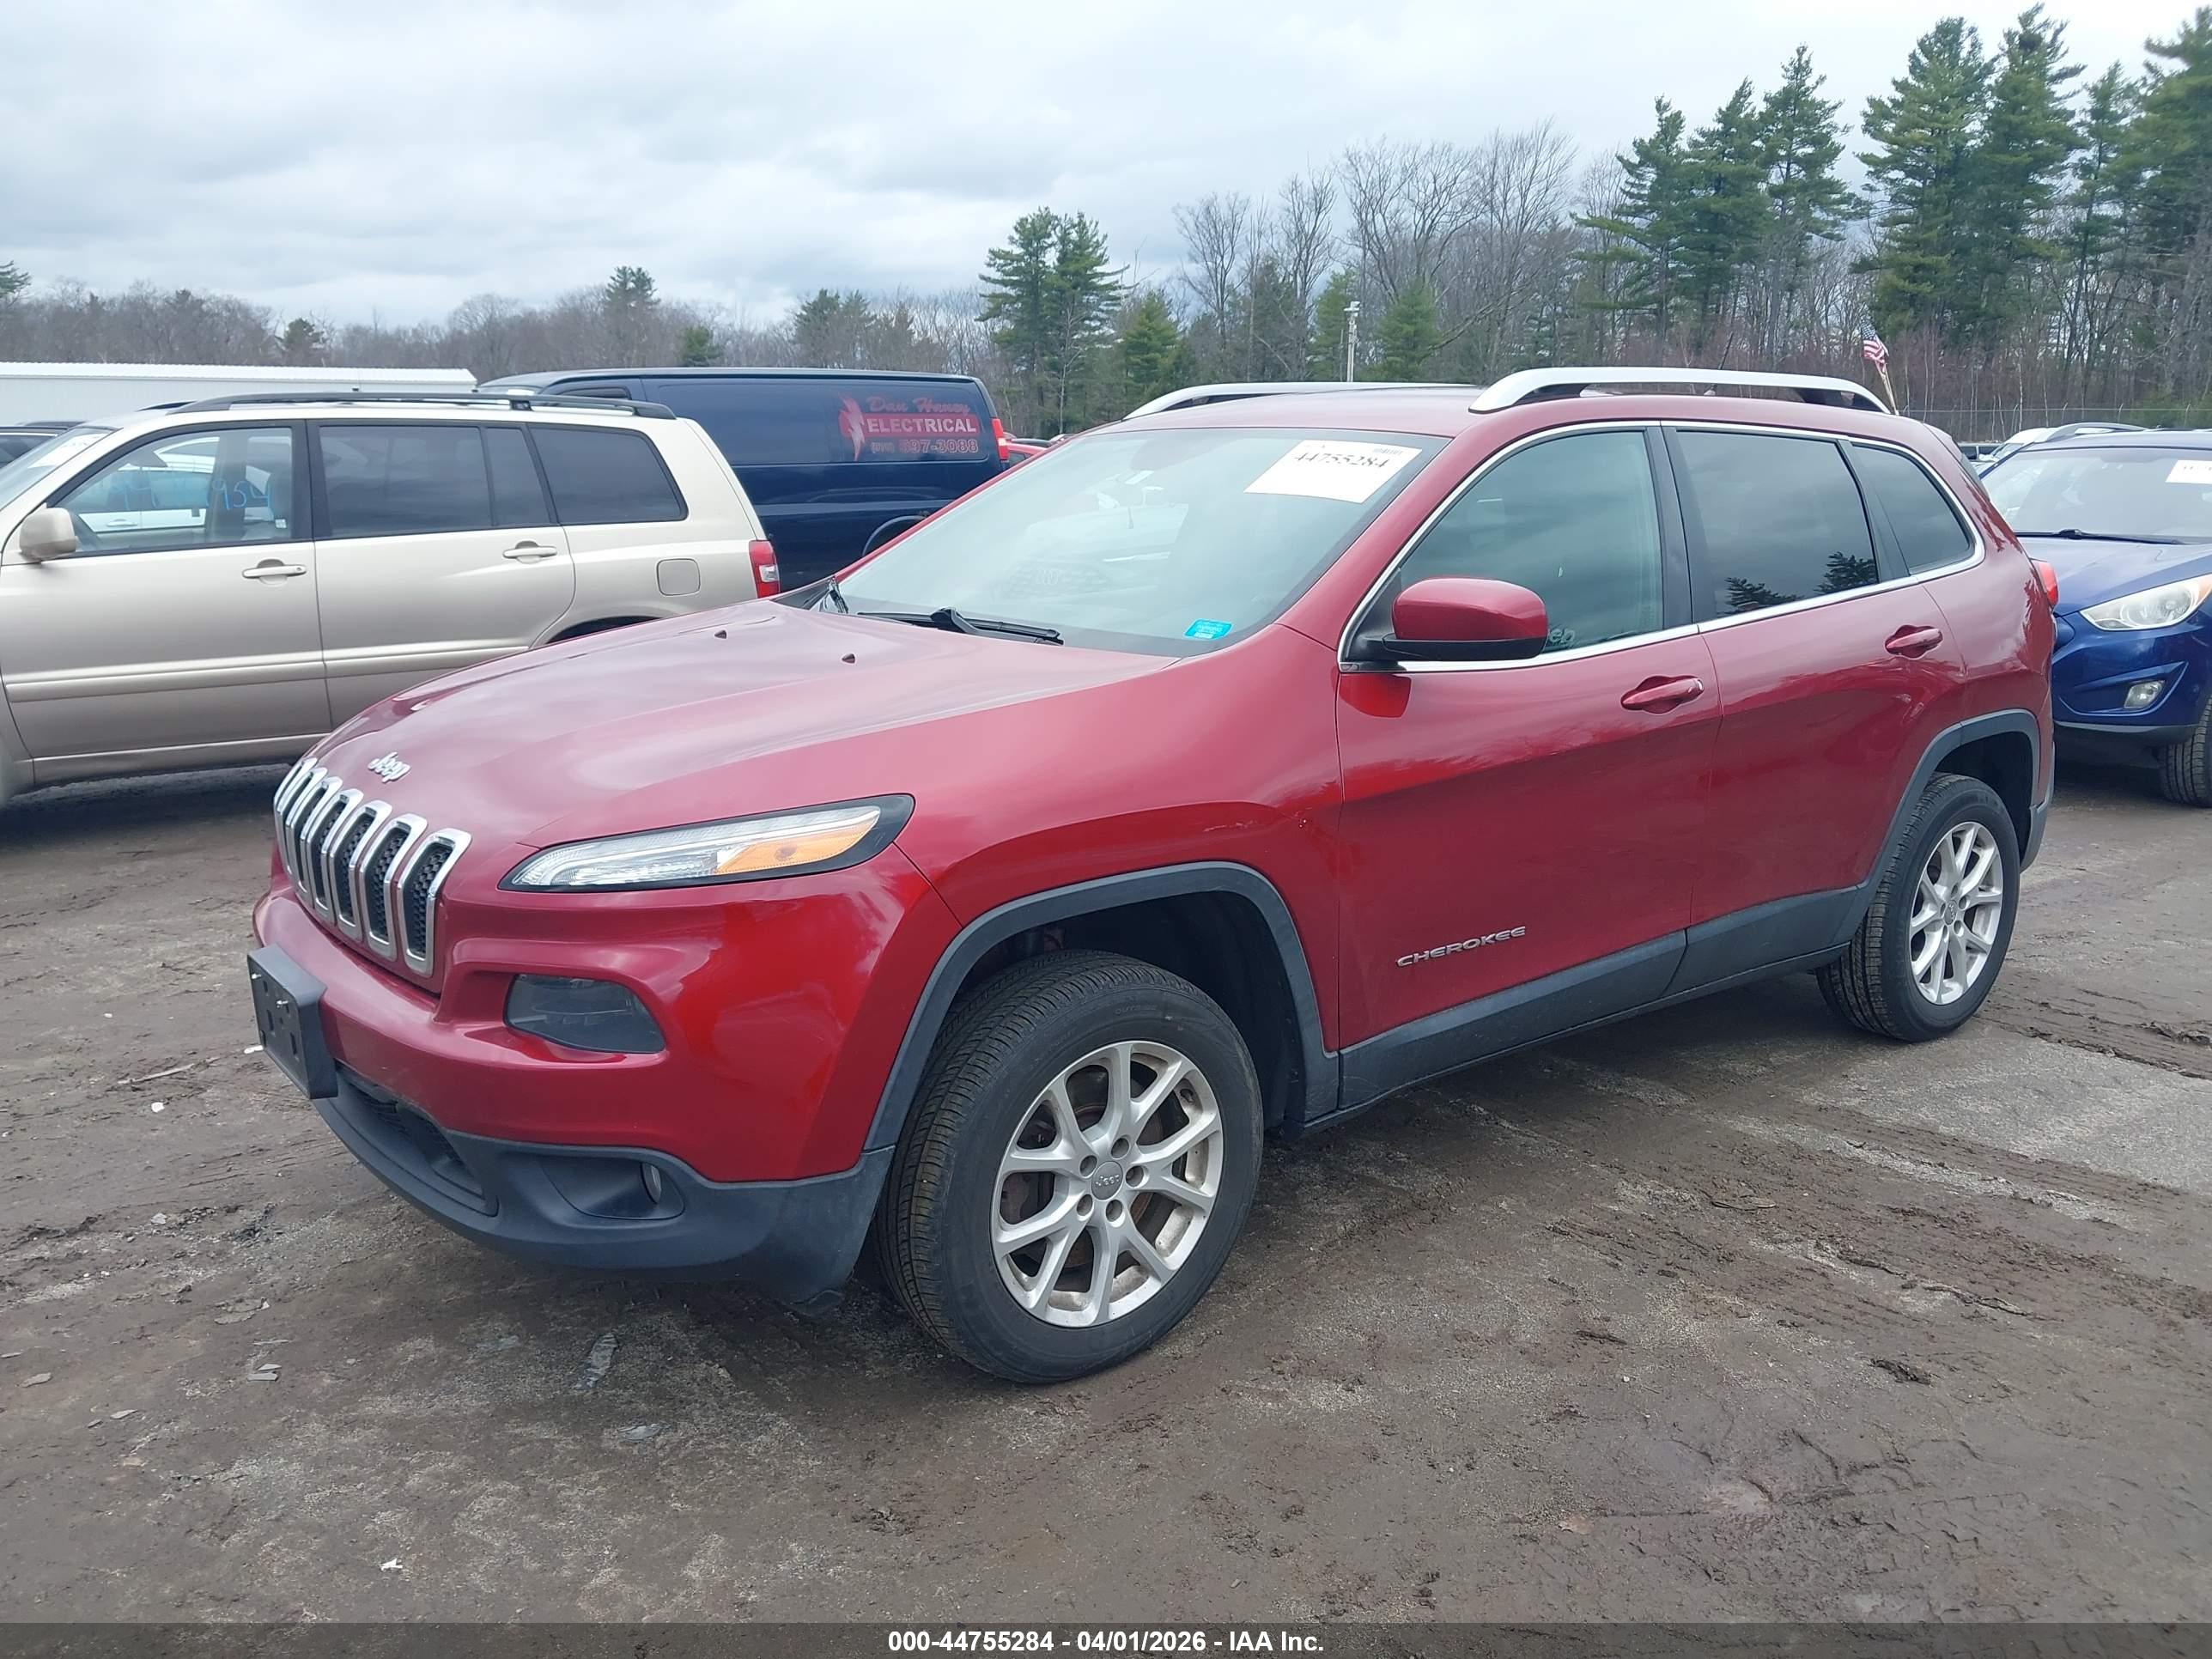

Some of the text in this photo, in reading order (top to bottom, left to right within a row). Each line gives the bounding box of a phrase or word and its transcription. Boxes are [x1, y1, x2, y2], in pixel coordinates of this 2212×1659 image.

[867, 418, 976, 433] ELECTRICAL
[1294, 452, 1389, 468] 44755284
[368, 751, 410, 782] Jeep
[1397, 926, 1526, 967] CHEROKEE
